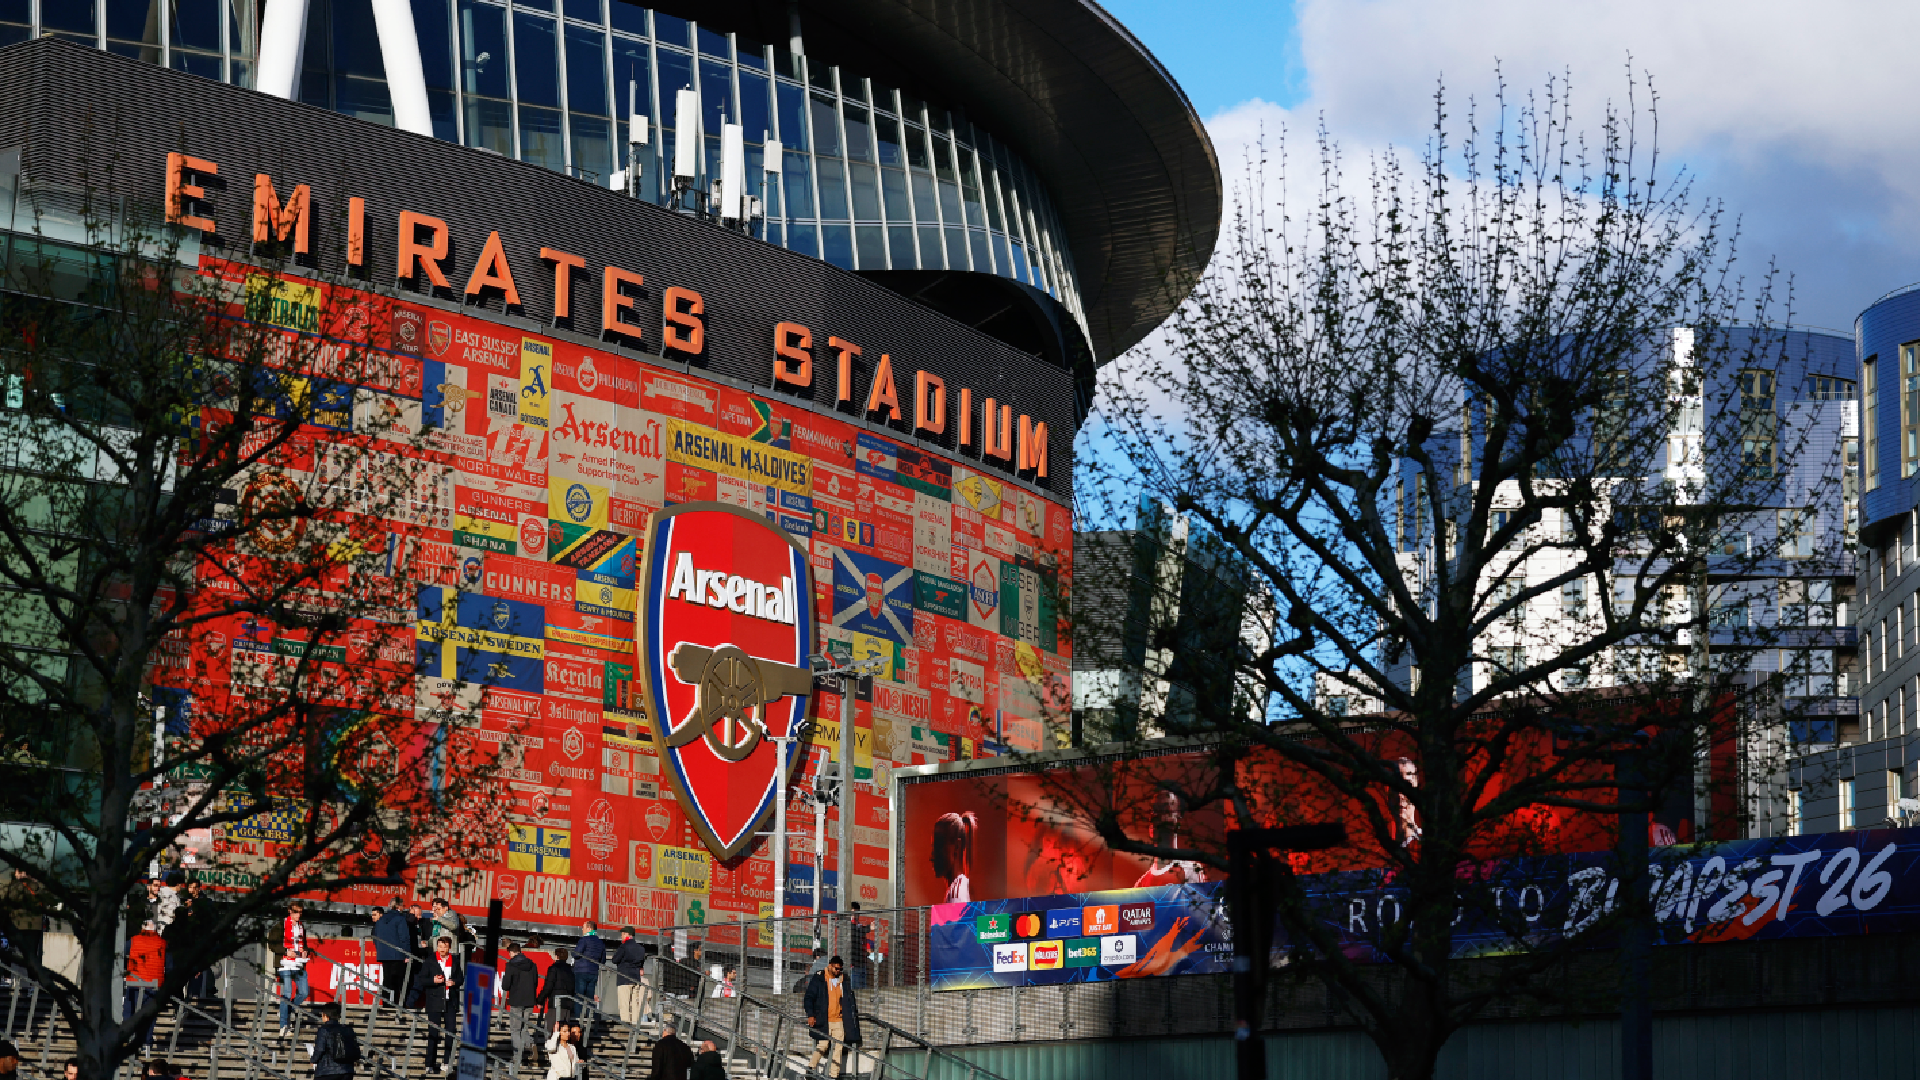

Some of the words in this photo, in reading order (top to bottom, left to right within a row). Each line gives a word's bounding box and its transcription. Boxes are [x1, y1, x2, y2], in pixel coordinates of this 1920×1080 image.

[165, 151, 705, 356] EMIRATES
[774, 321, 1048, 478] STADIUM
[455, 329, 480, 348] EAST
[482, 336, 518, 356] SUSSEX
[463, 349, 510, 370] ARSENAL
[553, 362, 576, 379] ARSENAL
[490, 388, 517, 404] ARSENAL
[490, 401, 517, 416] CANADA
[721, 411, 736, 424] CAPE
[736, 414, 752, 427] TOWN
[552, 402, 662, 460] Arsenal
[793, 424, 840, 451] FERMANAGH
[582, 453, 607, 466] Armed
[610, 459, 635, 473] Forces
[674, 430, 736, 466] ARSENAL
[741, 447, 805, 485] MALDIVES
[457, 458, 499, 476] NORTH
[505, 467, 545, 485] WALES
[621, 473, 639, 486] Club
[718, 475, 747, 489] ARSENAL
[472, 492, 532, 512] GUNNERS
[459, 504, 514, 523] ARSENAL
[920, 510, 946, 526] ARSENAL
[463, 534, 506, 551] GHANA
[916, 545, 948, 562] YORKSHIRE
[487, 571, 572, 601] GUNNERS
[669, 552, 795, 625] Arsenal
[488, 637, 541, 654] SWEDEN
[547, 660, 602, 689] Kerala
[548, 701, 600, 725] Islington
[549, 761, 595, 780] Gooners
[528, 845, 563, 857] ARSENAL
[664, 849, 705, 863] ARSENAL
[413, 863, 494, 907] ARSENAL
[663, 876, 678, 887] ARE
[681, 878, 705, 889] MAGIC
[1816, 842, 1897, 916] 26
[382, 885, 407, 895] JAPAN
[522, 875, 594, 918] GEORGIA
[1058, 918, 1079, 927] PS5
[1123, 908, 1151, 922] QATAR
[980, 929, 1007, 940] Heineken
[1089, 924, 1101, 933] JUST
[997, 950, 1024, 964] FedEx
[1067, 946, 1097, 959] bet365
